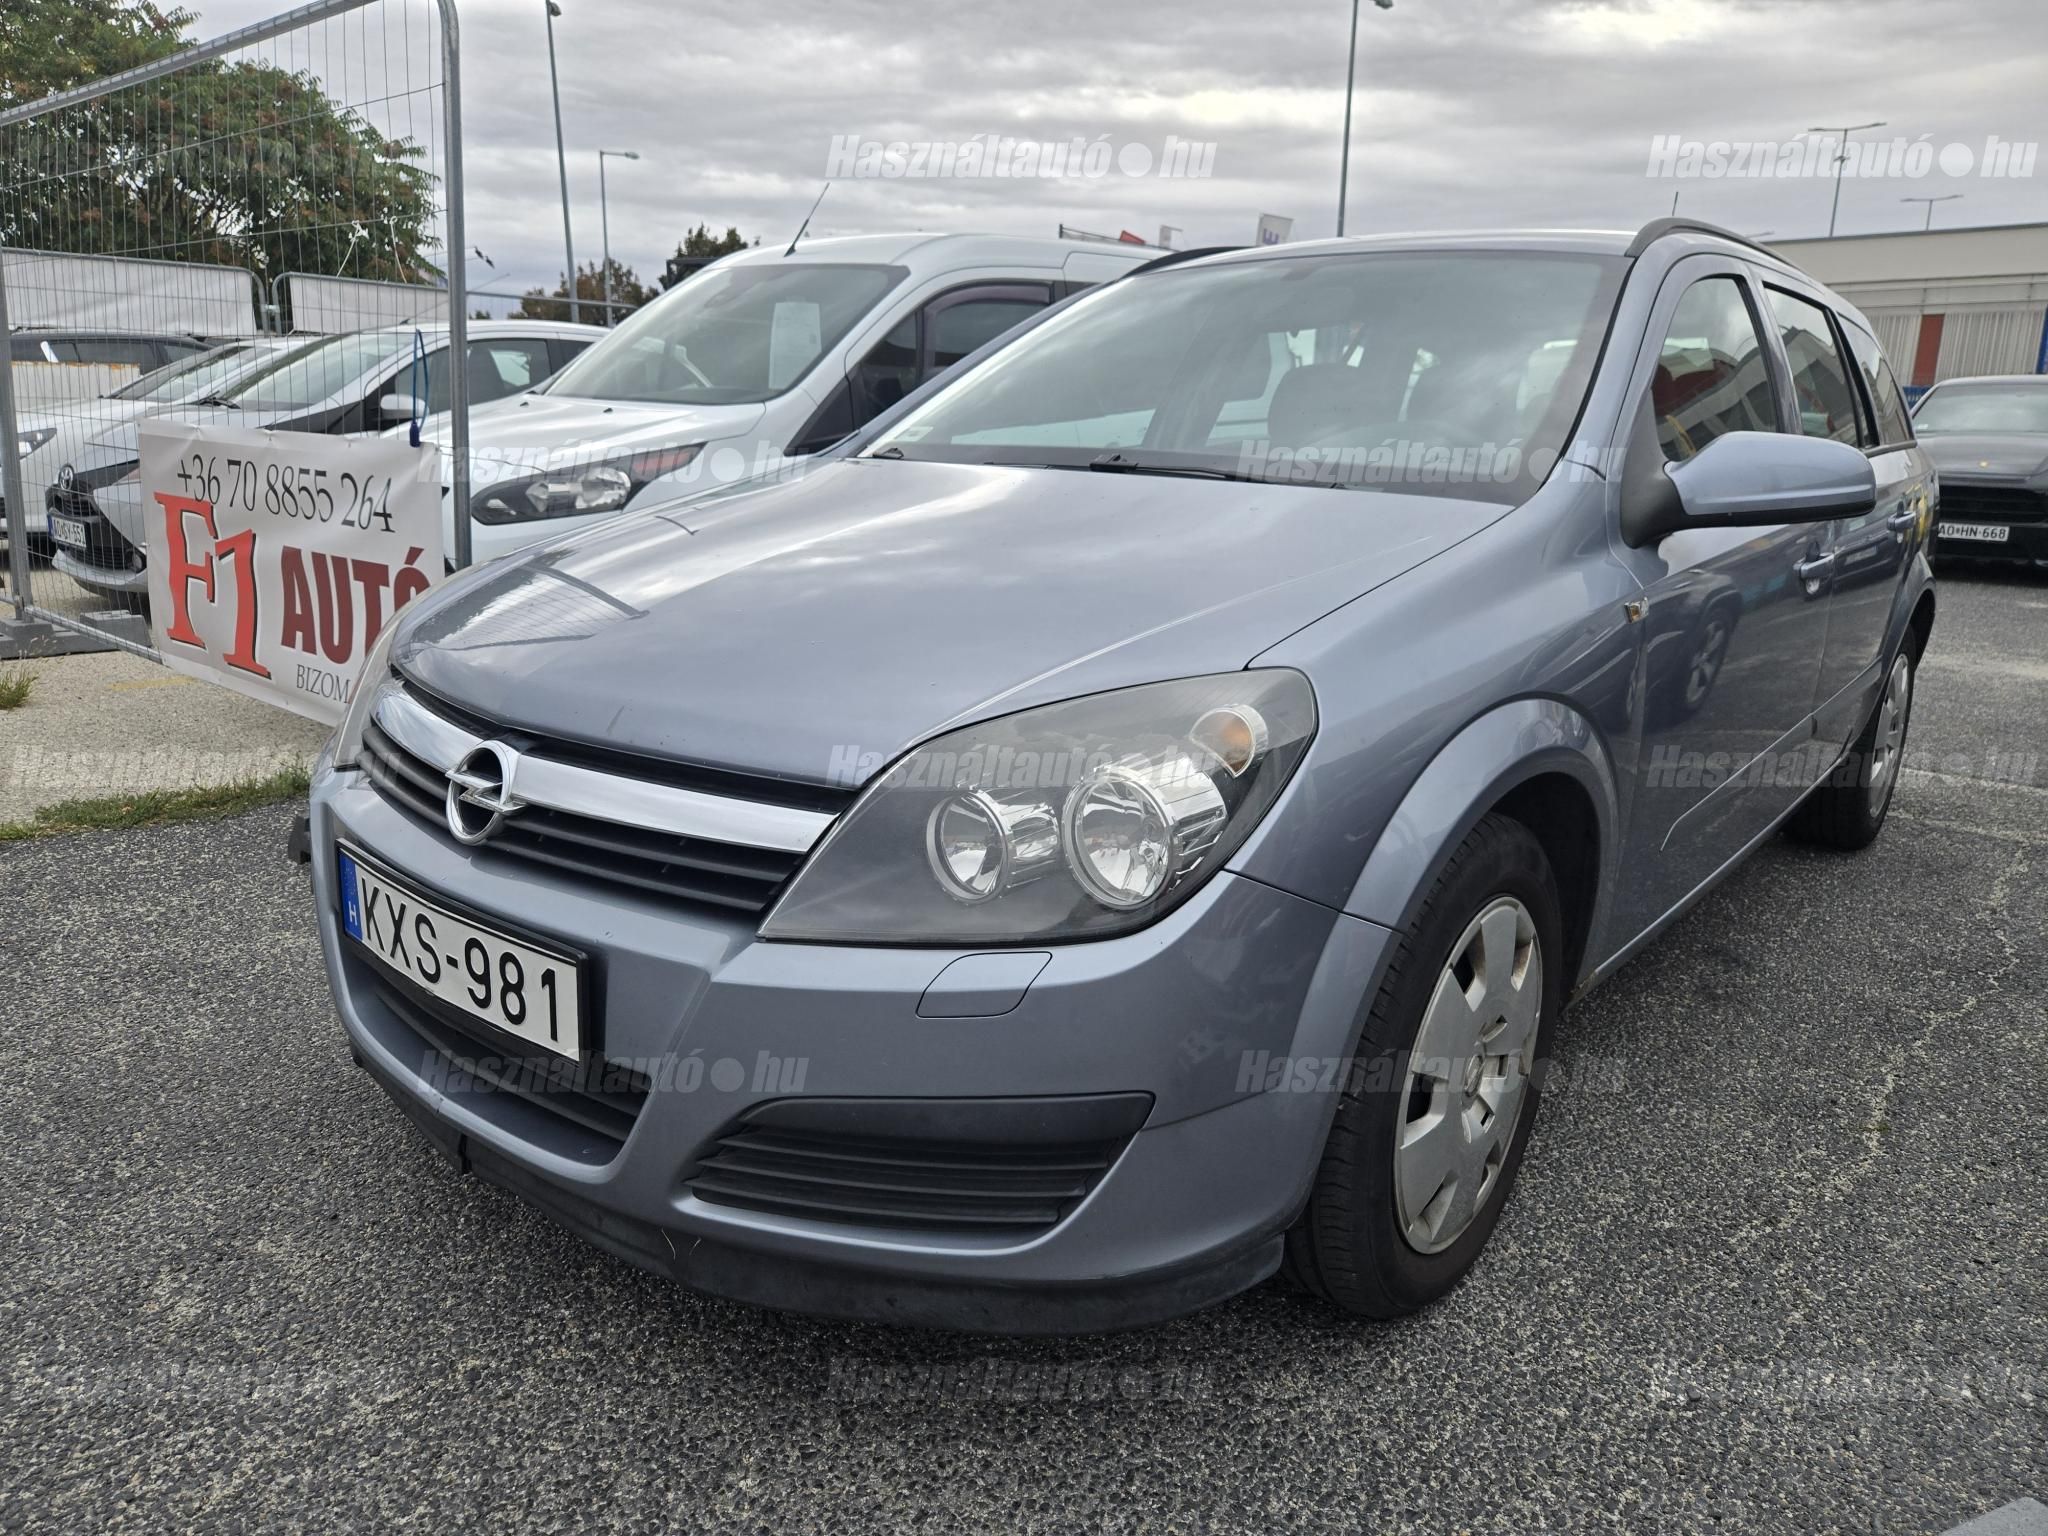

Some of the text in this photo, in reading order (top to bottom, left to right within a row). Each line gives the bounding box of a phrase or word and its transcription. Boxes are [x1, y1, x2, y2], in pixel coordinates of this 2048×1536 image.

[177, 454, 395, 532] +36 70 8855 264
[154, 492, 272, 680] F1
[348, 877, 559, 1042] H KXS-981
